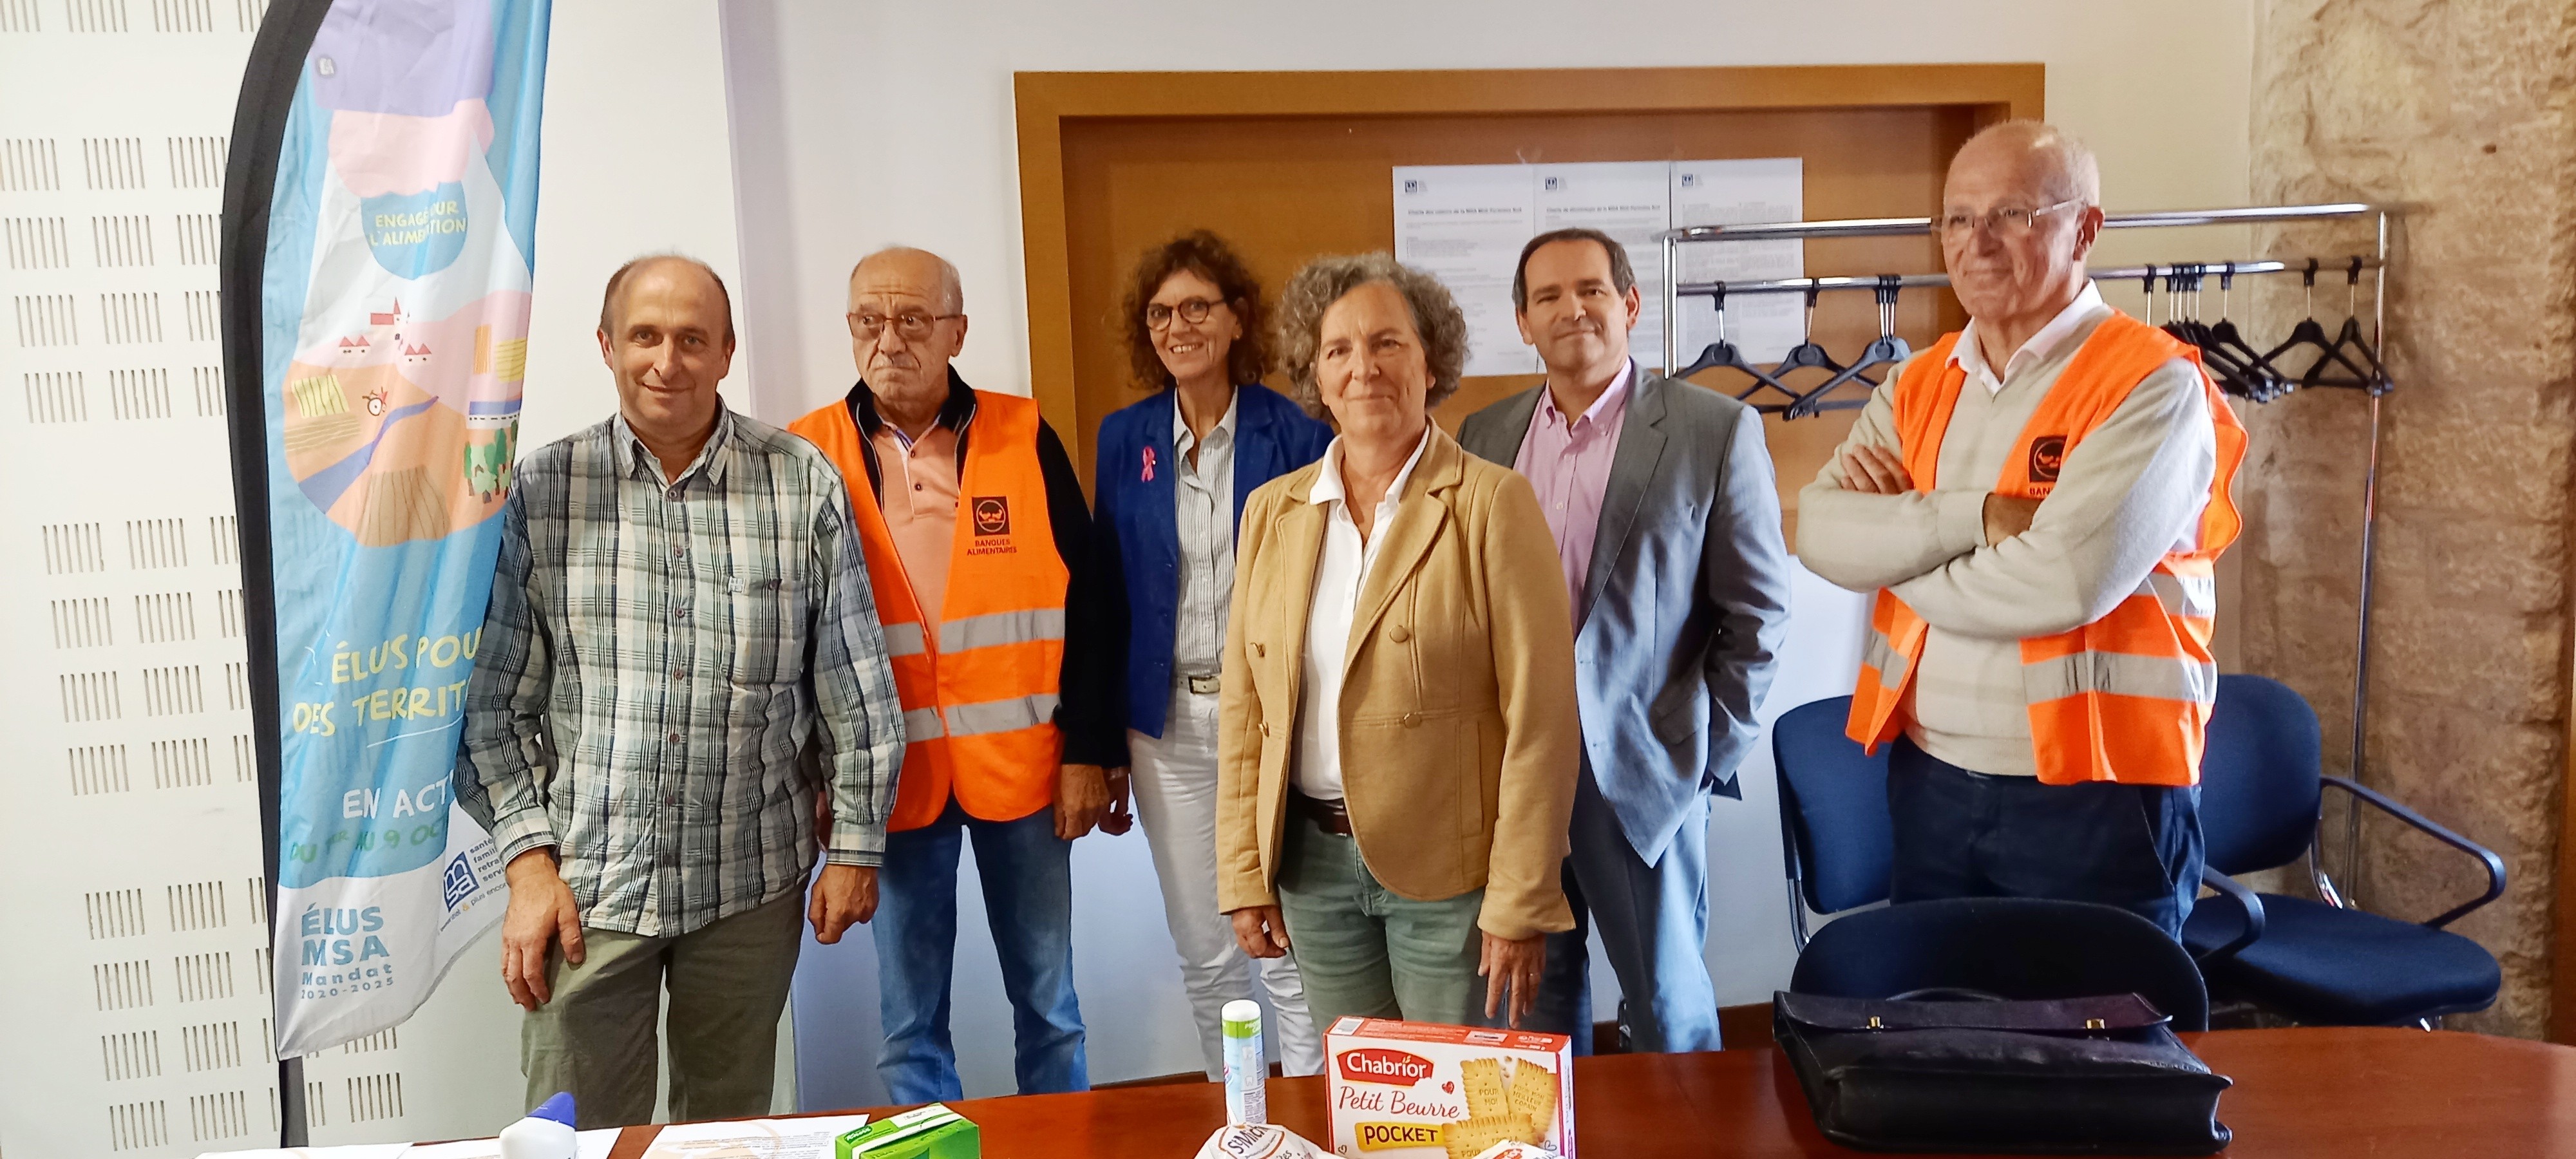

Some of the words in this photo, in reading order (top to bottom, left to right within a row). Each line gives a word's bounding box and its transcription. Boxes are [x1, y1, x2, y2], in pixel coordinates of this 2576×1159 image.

[2029, 487, 2052, 495] BAN
[967, 547, 1018, 556] ALIMENTAIRES
[975, 538, 1010, 547] BANQUES
[332, 634, 408, 684] ÉLUS
[416, 627, 482, 668] POU
[292, 701, 336, 737] DES
[352, 679, 468, 726] TERRIT
[343, 788, 380, 819] EN
[393, 775, 452, 818] ACT
[290, 842, 317, 863] DU
[383, 829, 401, 849] 9
[410, 824, 438, 845] OC
[477, 858, 500, 873] retra
[482, 867, 506, 882] servi
[470, 893, 486, 906] plus
[487, 882, 509, 896] encor
[302, 902, 384, 937] ÉLUS
[301, 936, 390, 966] MSA
[302, 964, 392, 985] Mandat
[301, 977, 393, 999] 2020-2025
[1346, 1050, 1427, 1078] Chabrior
[1338, 1085, 1385, 1112] Petit
[1390, 1091, 1461, 1119] Beurre
[1479, 1088, 1499, 1097] POUR
[1363, 1124, 1439, 1145] POCKET
